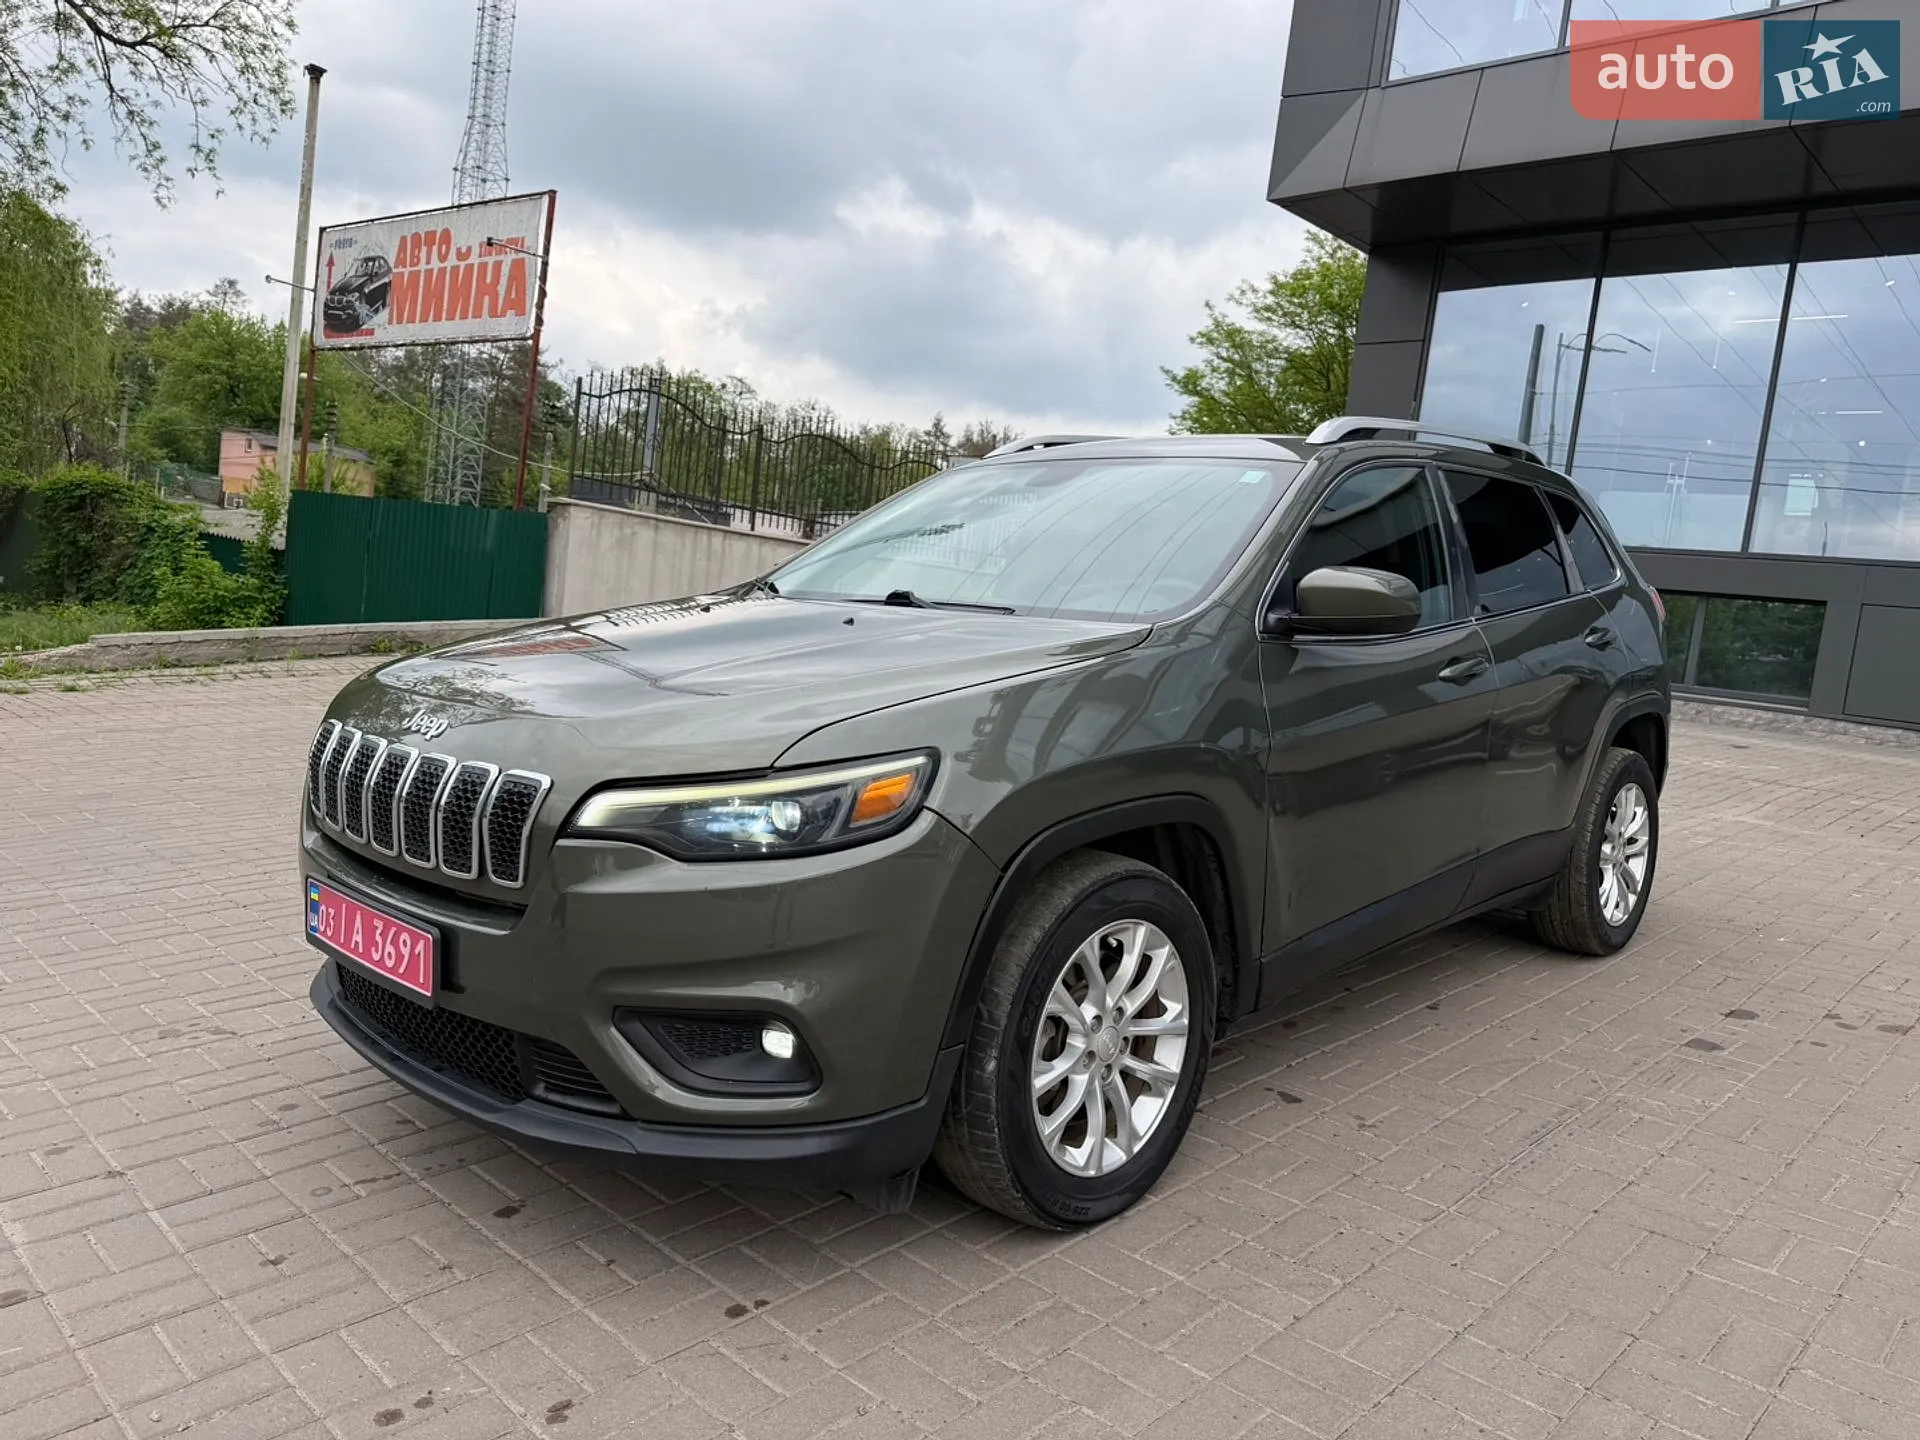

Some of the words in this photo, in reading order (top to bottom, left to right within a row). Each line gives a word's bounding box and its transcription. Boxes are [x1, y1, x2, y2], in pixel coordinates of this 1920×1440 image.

[393, 227, 452, 269] АВТО
[401, 709, 449, 741] Jeep
[370, 918, 425, 984] 3691
